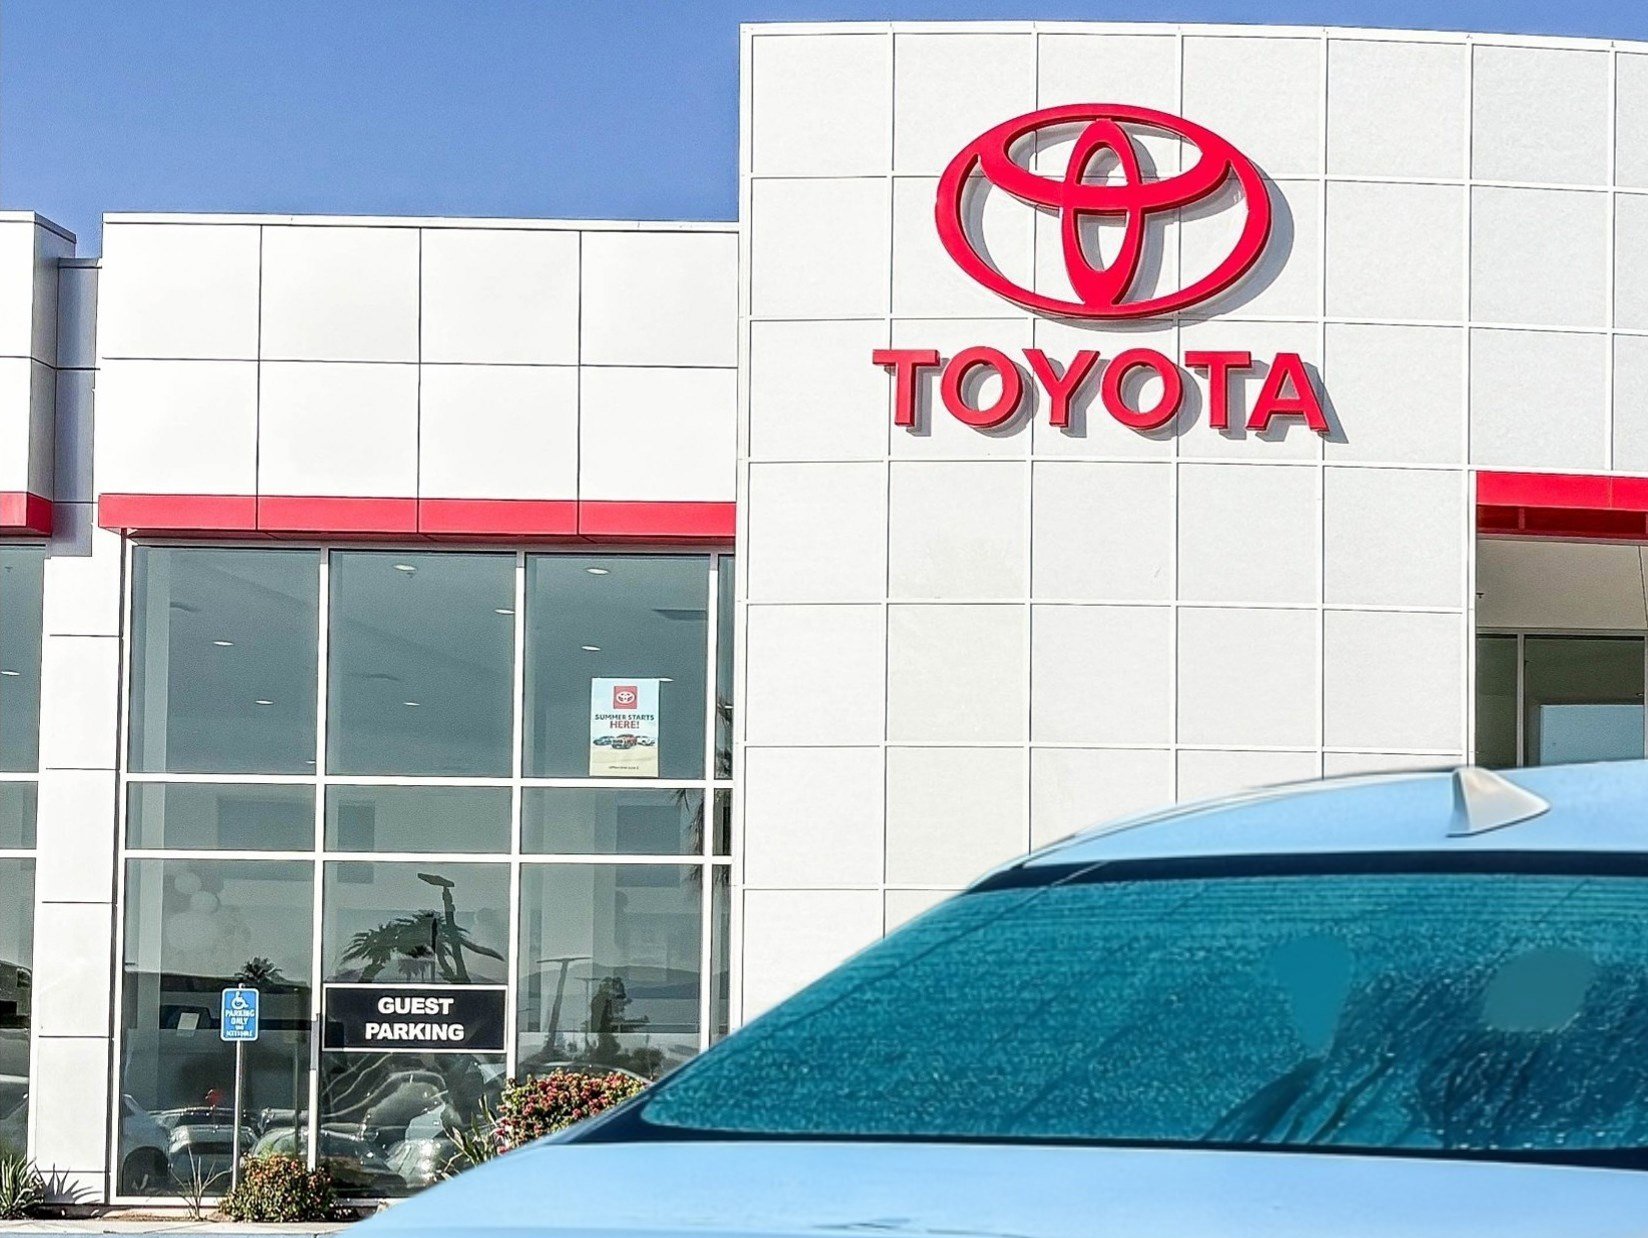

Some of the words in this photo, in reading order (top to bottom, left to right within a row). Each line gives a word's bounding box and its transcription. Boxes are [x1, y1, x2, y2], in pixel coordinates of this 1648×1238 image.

[872, 345, 1329, 432] TOYOTA
[609, 721, 640, 729] HERE!
[225, 1009, 255, 1017] PARKING
[377, 997, 454, 1015] GUEST
[365, 1023, 465, 1041] PARKING
